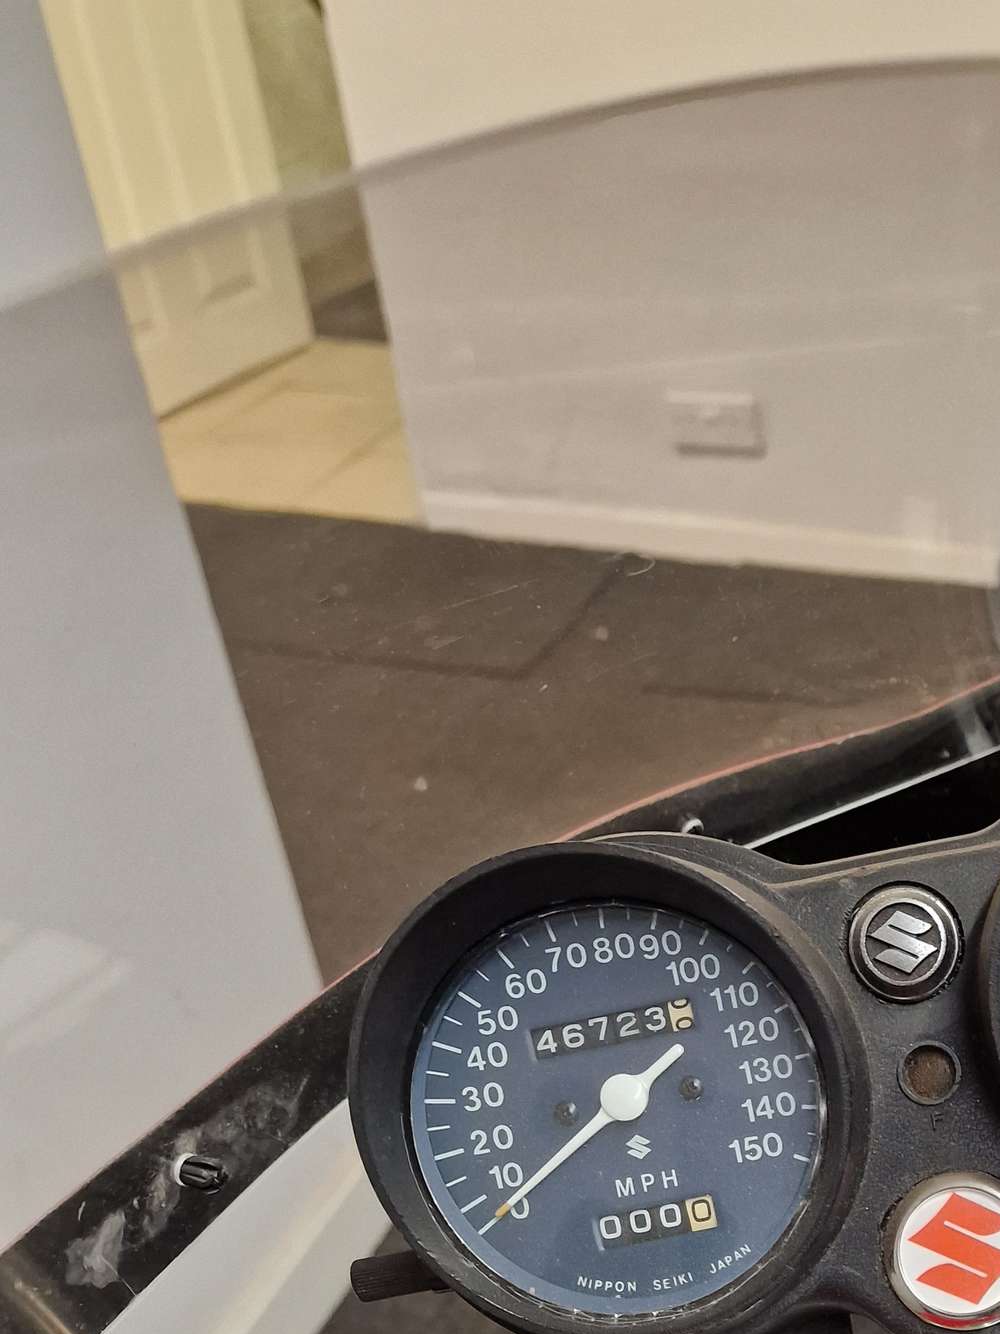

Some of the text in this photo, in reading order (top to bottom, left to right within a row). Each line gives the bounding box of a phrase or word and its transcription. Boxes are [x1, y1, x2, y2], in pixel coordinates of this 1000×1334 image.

[545, 943, 587, 972] 70
[593, 933, 634, 963] 80
[639, 931, 681, 960] 90
[505, 969, 547, 998] 60
[666, 954, 720, 985] 100
[710, 982, 759, 1011] 110
[477, 1006, 518, 1035] 50
[725, 1017, 779, 1047] 120
[467, 1042, 508, 1071] 40
[739, 1055, 793, 1084] 130
[462, 1082, 504, 1111] 30
[742, 1092, 796, 1122] 140
[470, 1125, 513, 1155] 20
[729, 1133, 783, 1163] 150
[489, 1162, 523, 1189] 10
[615, 1170, 678, 1198] MPH
[577, 1244, 751, 1293] NIPPON SEIKI JAPAN
